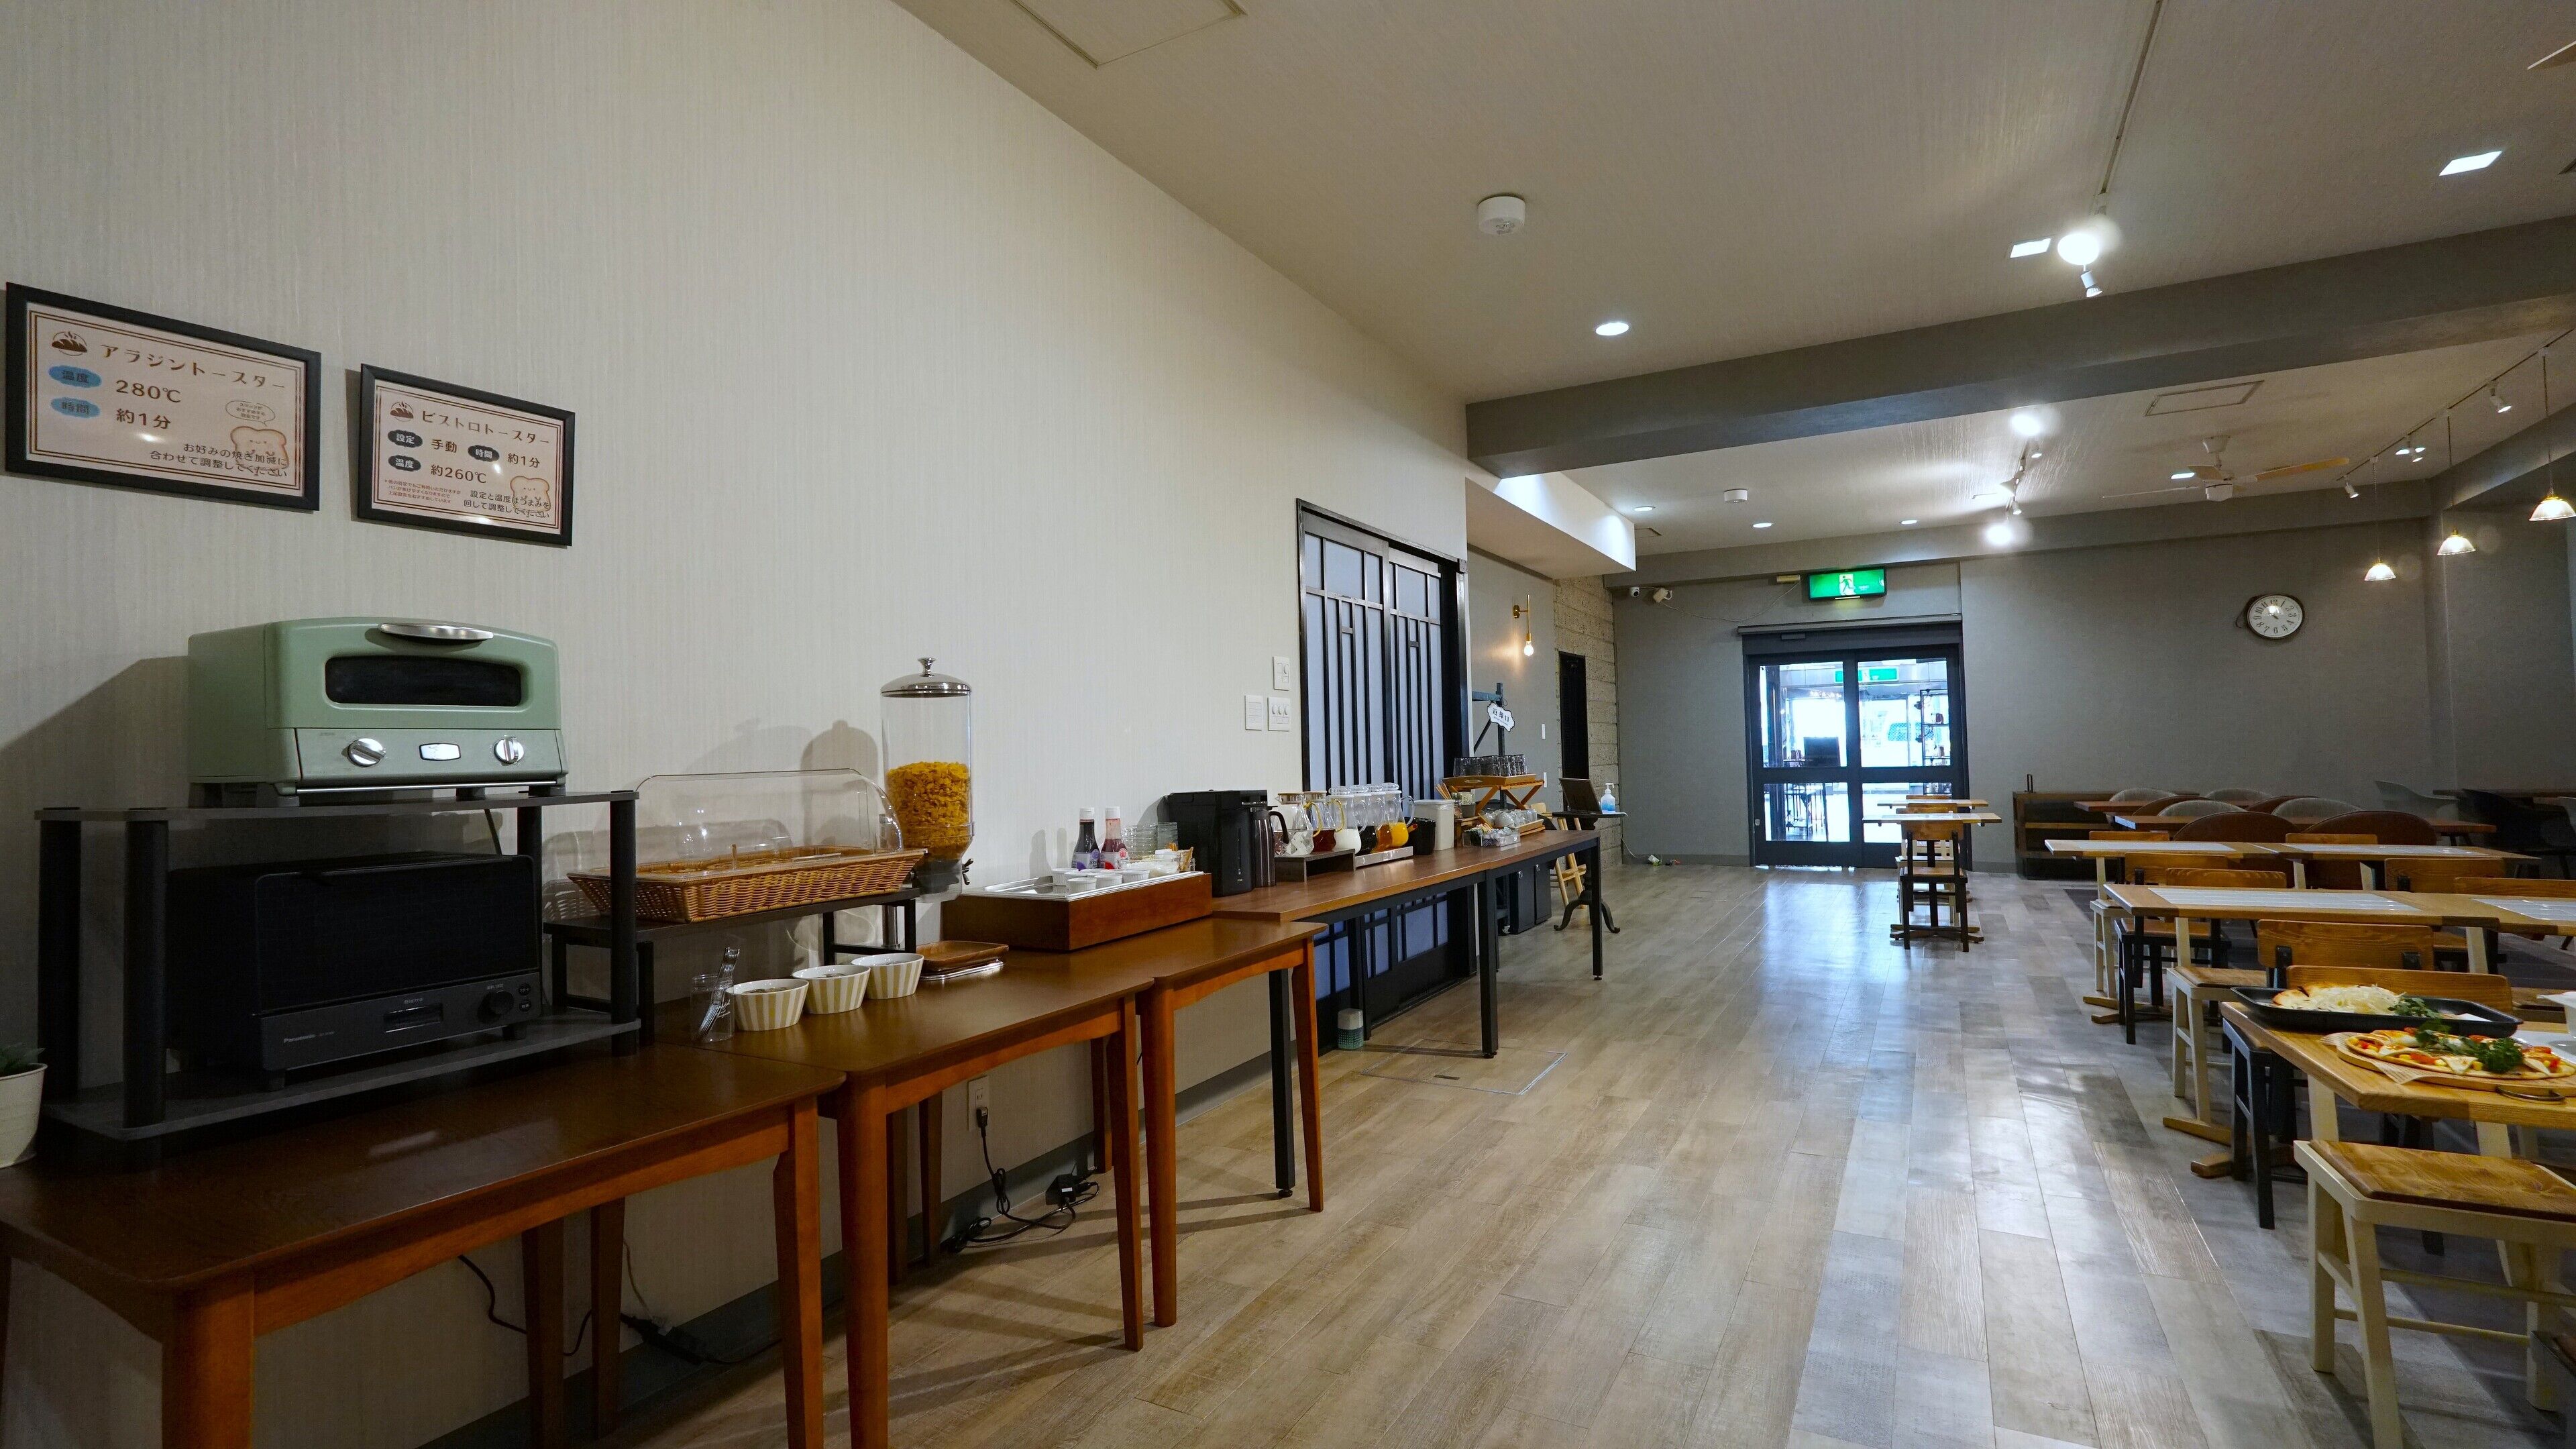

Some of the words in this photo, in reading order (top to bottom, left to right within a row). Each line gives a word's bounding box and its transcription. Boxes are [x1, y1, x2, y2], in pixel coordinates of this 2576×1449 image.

[100, 343, 286, 389] アラジントースター
[60, 370, 89, 384] 温度
[115, 380, 182, 404] 280℃
[115, 408, 172, 430] 約1分
[422, 410, 549, 444] ビストロトースター
[396, 433, 415, 444] 設定
[431, 439, 458, 453] 手動
[183, 443, 287, 466] お好みの焼き加減に
[475, 448, 492, 459] 時間
[507, 453, 540, 468] 約1分
[150, 450, 287, 477] 合わせて調整してください
[395, 458, 415, 469] 温度
[431, 464, 486, 483] 約260℃
[464, 499, 549, 519] 回して調整してください
[470, 490, 549, 510] 設定と温度はつまみを
[283, 1034, 317, 1043] Panasonic
